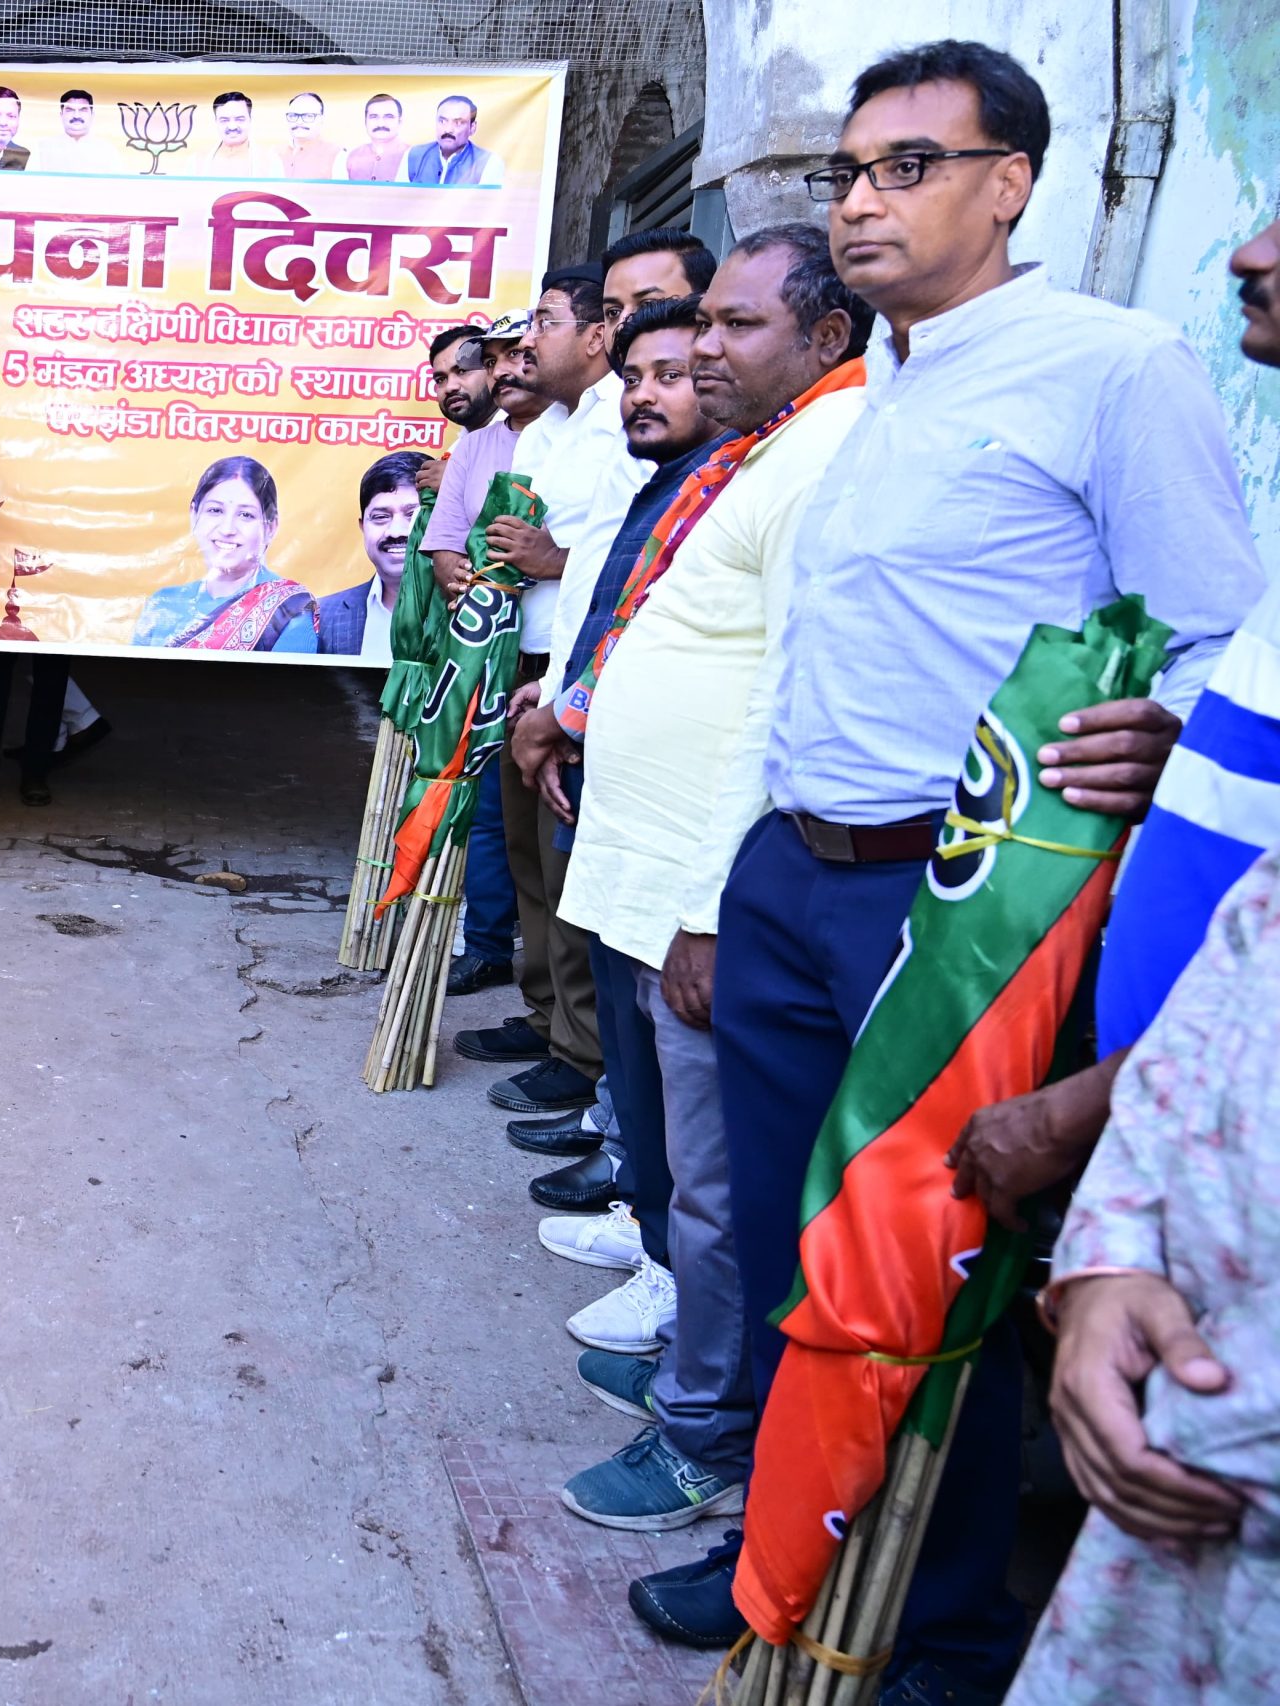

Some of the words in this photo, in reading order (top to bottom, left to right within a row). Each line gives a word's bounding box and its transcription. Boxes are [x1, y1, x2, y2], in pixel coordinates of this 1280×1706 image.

[207, 190, 508, 305] दिवस
[13, 304, 92, 340] शहर
[94, 301, 203, 344] दक्षिणी
[206, 303, 302, 345] विधान
[304, 316, 377, 348] सभा
[379, 310, 417, 349] के
[3, 350, 28, 387] 5
[121, 360, 231, 398] अध्यक्ष
[234, 357, 281, 395] को
[291, 366, 412, 401] स्थापना
[97, 398, 164, 442] झंडा
[316, 408, 448, 450] कार्यक्रम
